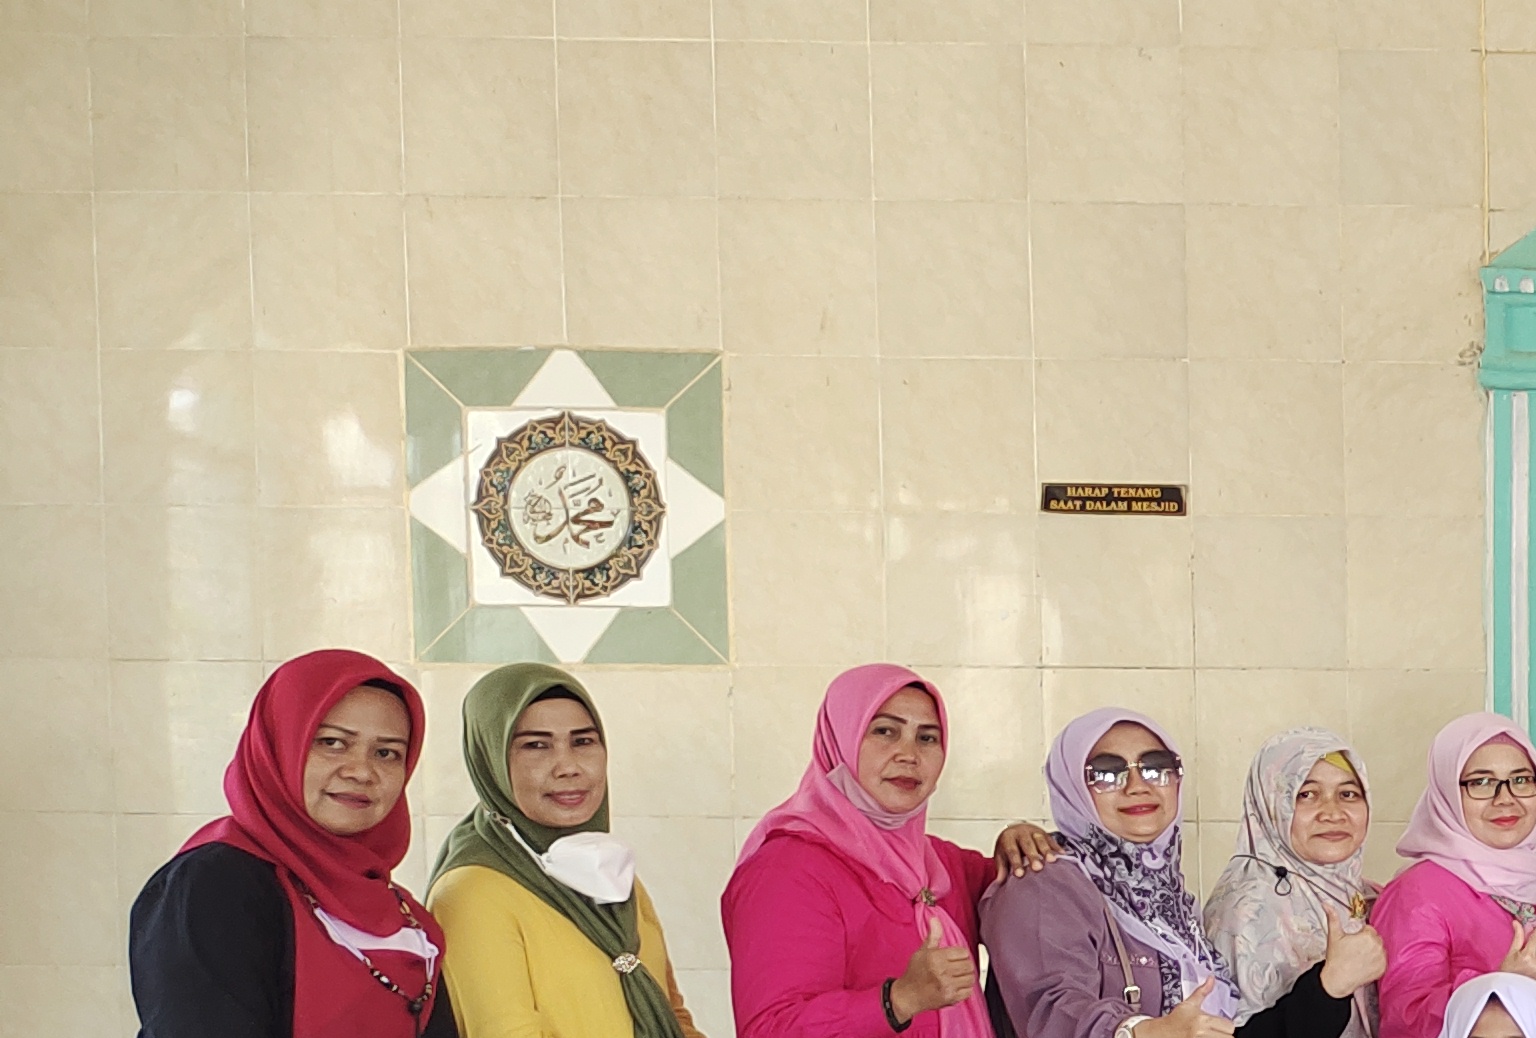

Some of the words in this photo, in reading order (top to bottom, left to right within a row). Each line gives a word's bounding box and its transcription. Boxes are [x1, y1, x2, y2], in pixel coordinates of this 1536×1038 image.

[1066, 487, 1109, 498] HARAP
[1111, 488, 1162, 498] TENANG
[1050, 500, 1082, 510] SAAT
[1085, 501, 1128, 511] DALAM
[1131, 502, 1179, 512] MESJID
